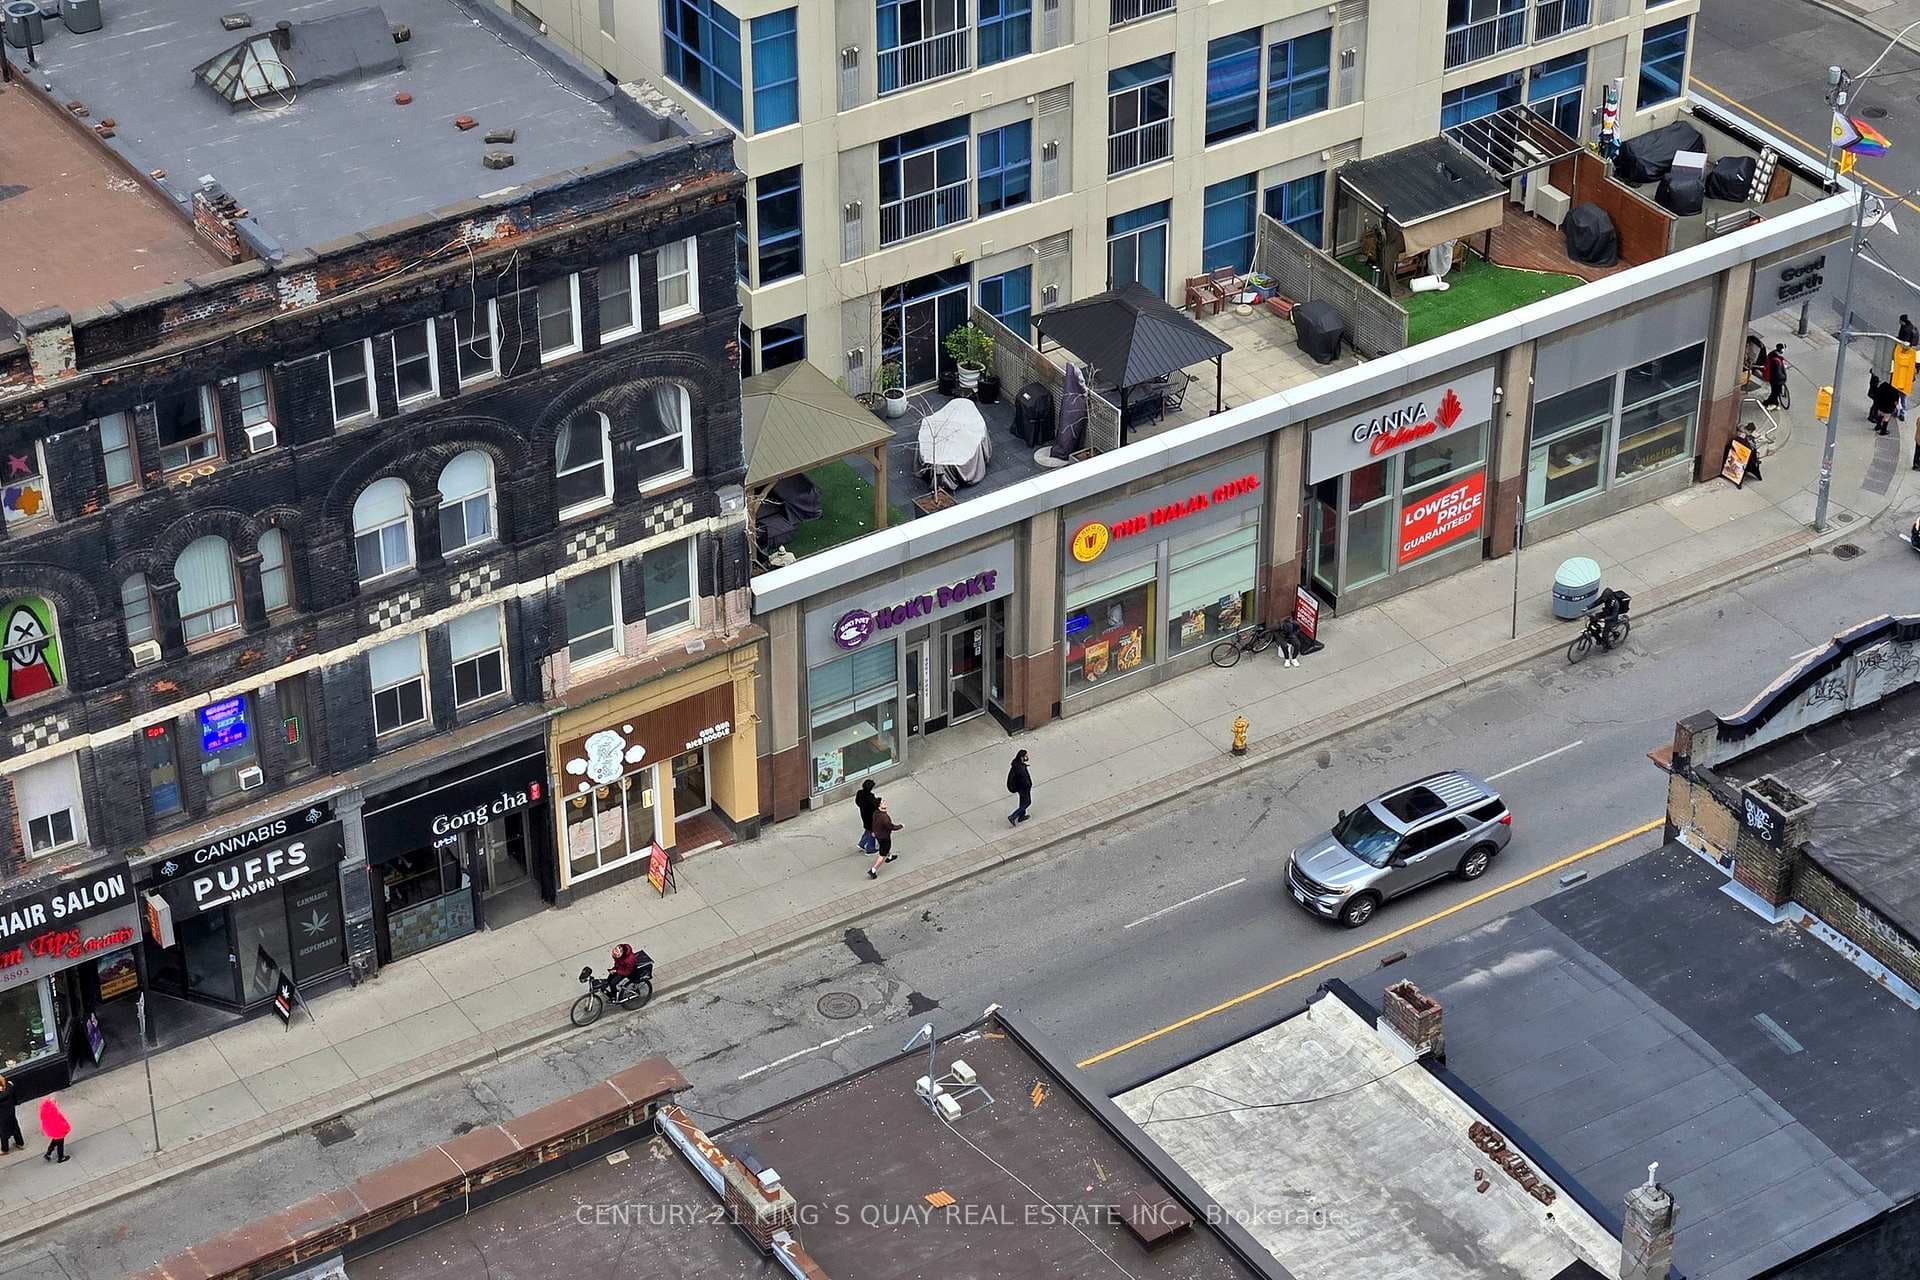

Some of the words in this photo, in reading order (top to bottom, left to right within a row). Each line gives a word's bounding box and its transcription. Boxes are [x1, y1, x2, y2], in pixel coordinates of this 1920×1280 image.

[1779, 274, 1823, 300] Earth
[1781, 256, 1826, 281] Good
[1353, 402, 1429, 443] CANNA
[1112, 513, 1148, 542] THE
[1151, 492, 1209, 526] HALAL
[1405, 485, 1469, 527] LOWEST
[1436, 493, 1482, 525] PRICE
[877, 594, 934, 629] HOKY
[937, 569, 998, 608] POKE
[686, 737, 703, 750] RICE
[432, 804, 489, 836] Gong
[492, 791, 529, 814] cha
[194, 820, 287, 864] CANNABIS
[193, 842, 307, 902] PUFFS
[231, 877, 275, 901] HAVEN
[0, 903, 47, 938] HAIR
[51, 874, 126, 919] SALON
[27, 928, 81, 958] Tips
